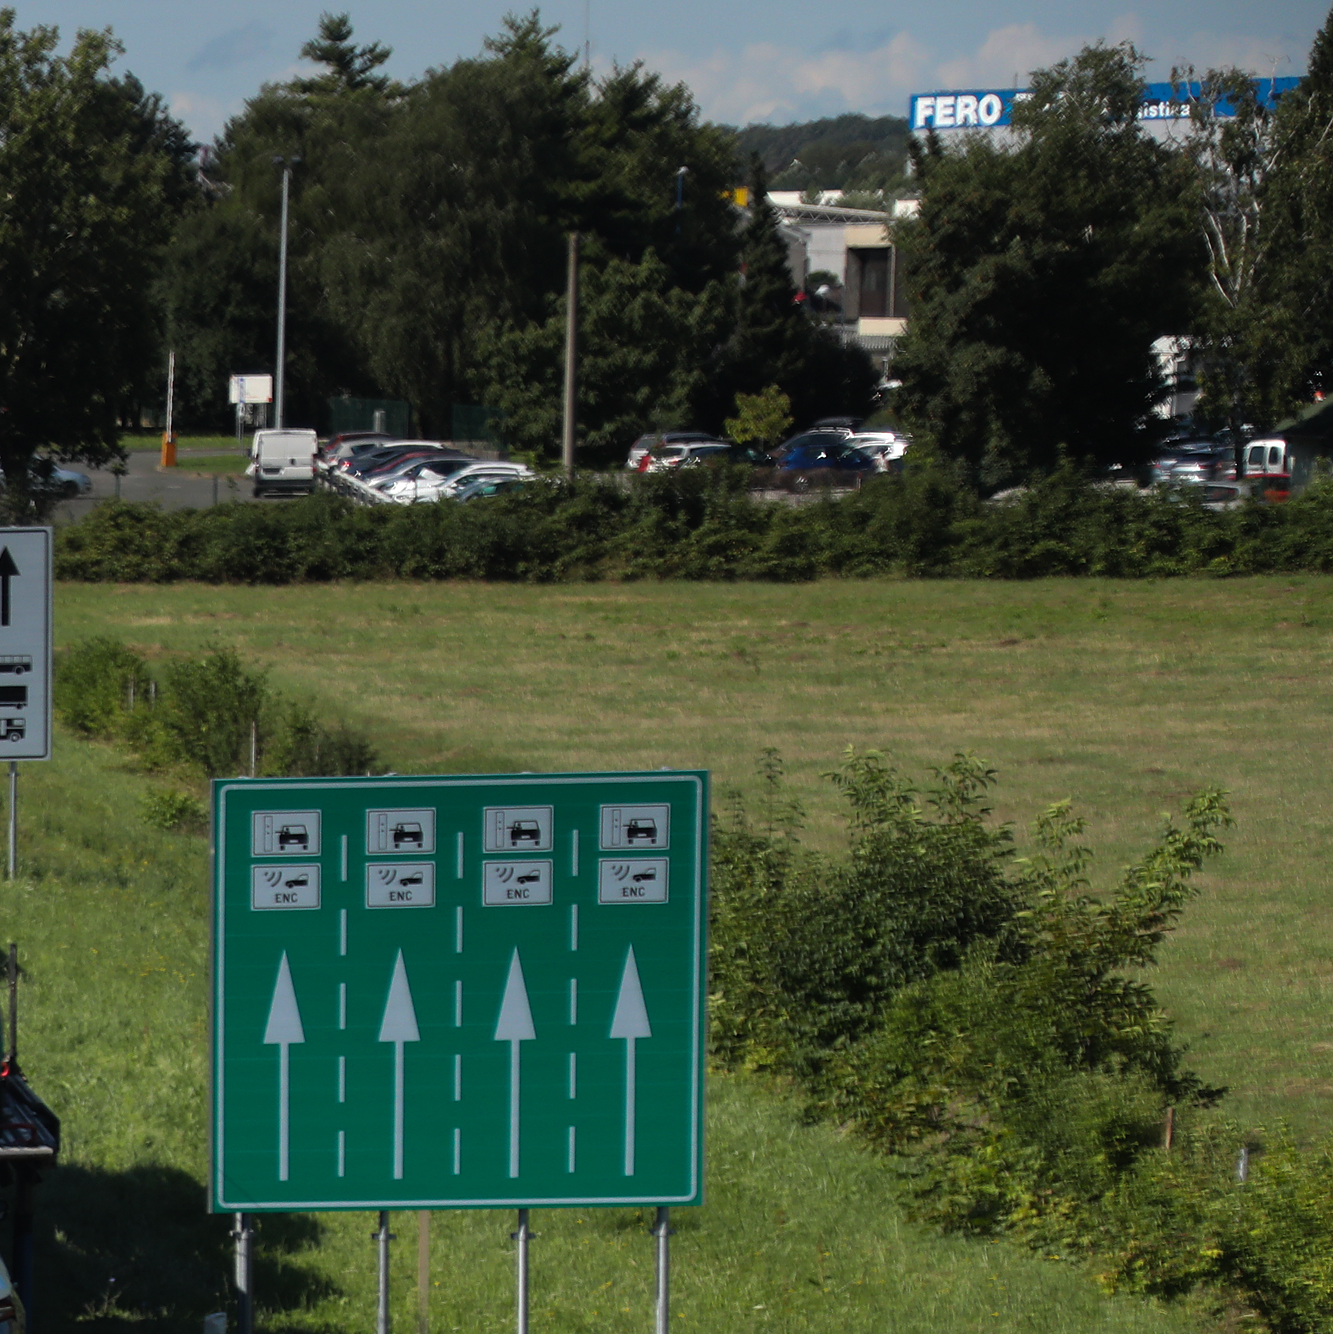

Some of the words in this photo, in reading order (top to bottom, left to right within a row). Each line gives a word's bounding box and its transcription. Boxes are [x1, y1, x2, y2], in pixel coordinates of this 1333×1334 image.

[915, 93, 1003, 127] FERO
[275, 892, 299, 904] ENC
[389, 890, 413, 902] ENC
[506, 888, 531, 900] ENC
[622, 886, 646, 898] ENC
